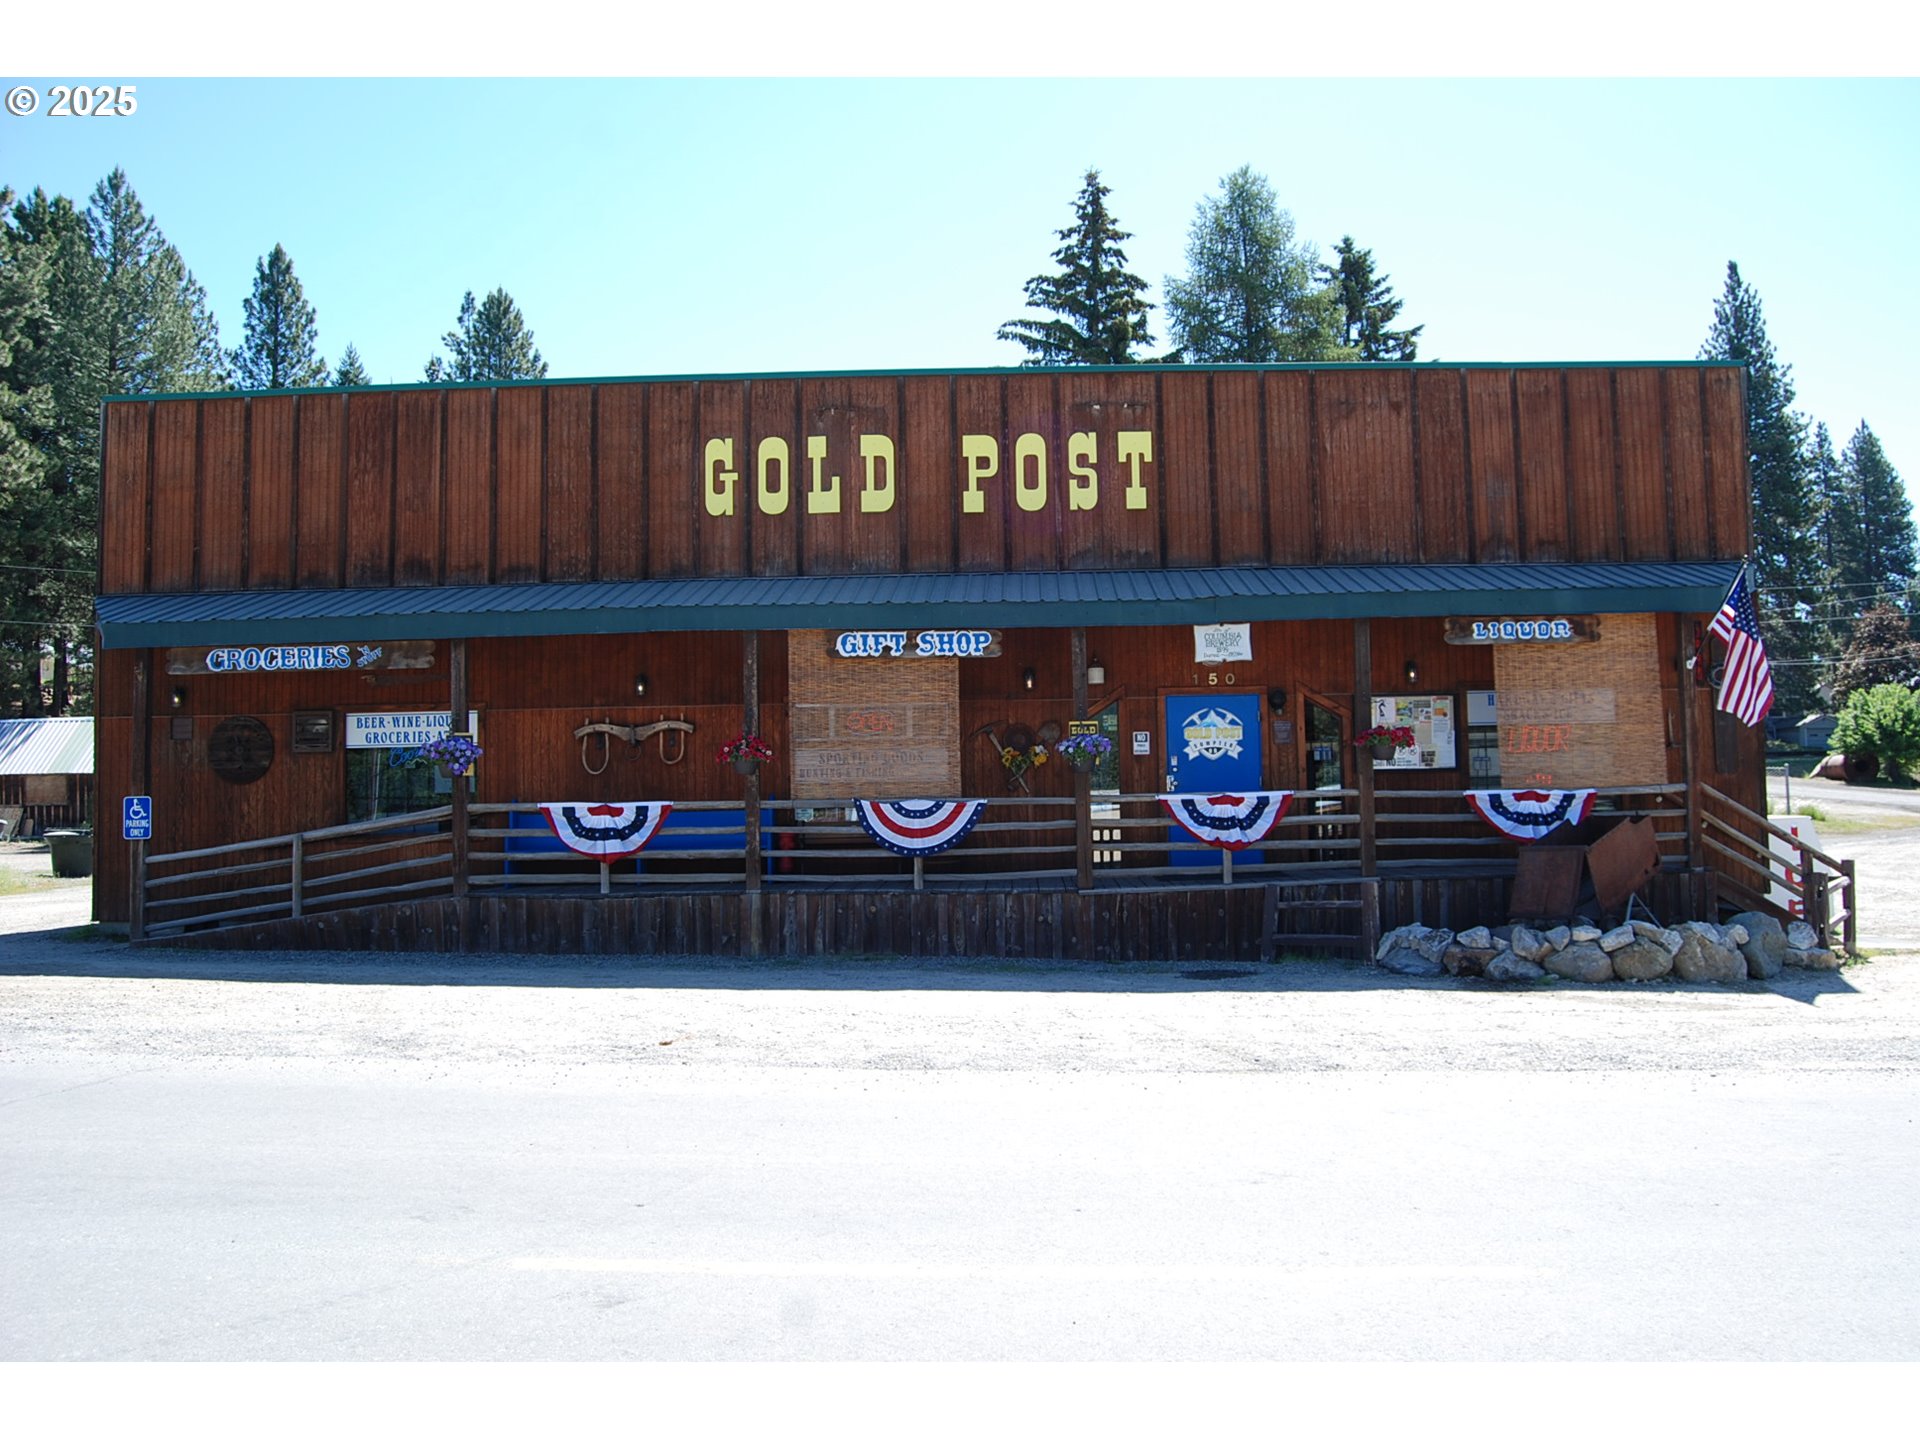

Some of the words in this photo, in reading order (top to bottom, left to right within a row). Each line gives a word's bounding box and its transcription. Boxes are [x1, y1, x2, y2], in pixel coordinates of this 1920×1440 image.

[704, 435, 895, 516] GOLD
[962, 431, 1153, 512] POST
[1473, 620, 1574, 640] LIQUOR
[835, 631, 907, 657] GIFT
[915, 630, 992, 656] SHOP
[206, 645, 351, 672] GROCERIES
[356, 717, 386, 729] BEER
[392, 715, 420, 728] WINE
[365, 730, 431, 744] GROCERIES
[125, 819, 150, 828] PARKING
[130, 828, 145, 837] ONLY
